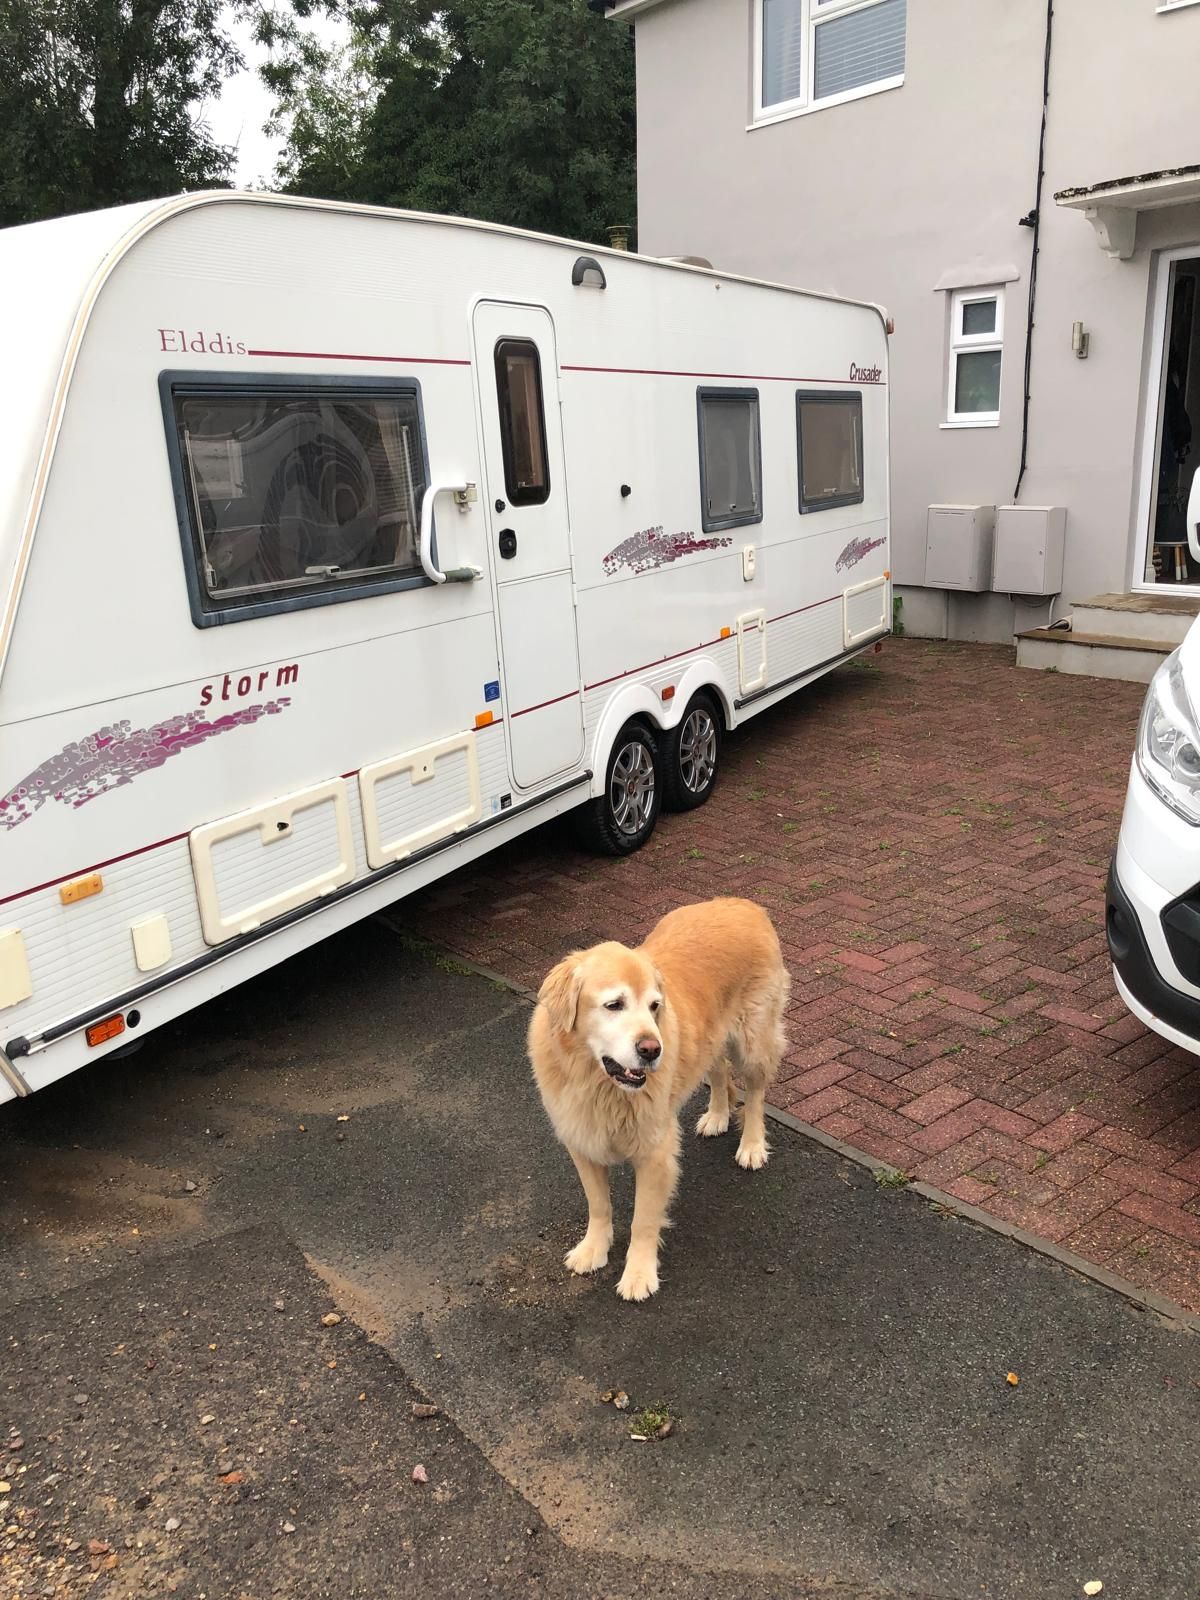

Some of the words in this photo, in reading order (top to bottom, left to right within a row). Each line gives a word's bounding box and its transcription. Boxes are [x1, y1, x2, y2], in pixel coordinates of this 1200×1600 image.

[157, 328, 246, 355] Elddis
[850, 362, 882, 382] Crusader
[200, 664, 299, 706] storm
